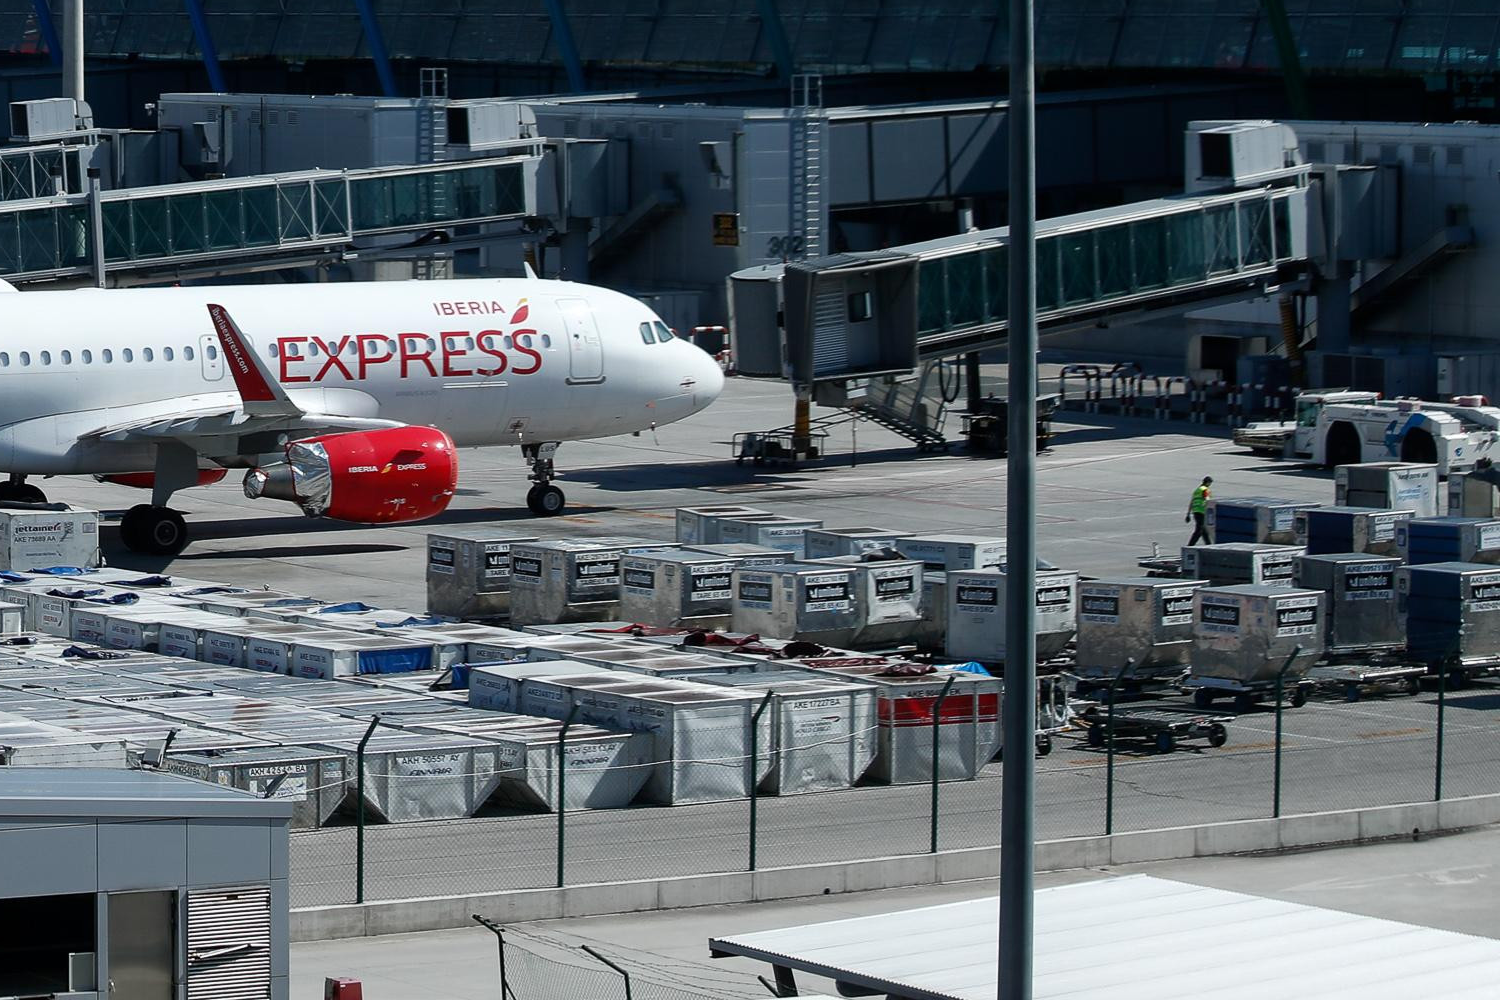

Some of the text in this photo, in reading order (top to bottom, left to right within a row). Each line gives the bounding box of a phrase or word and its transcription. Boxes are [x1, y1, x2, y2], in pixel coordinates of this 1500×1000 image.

[433, 300, 506, 316] IBERIA
[211, 306, 249, 374] iberiaexpress.com
[277, 329, 543, 384] EXPRESS
[348, 463, 427, 474] IBERIA EXPRESS
[793, 699, 808, 709] AKE
[402, 756, 420, 765] AKH
[250, 767, 264, 776] AKH
[294, 764, 306, 773] BA
[408, 767, 452, 777] FINNAIR
